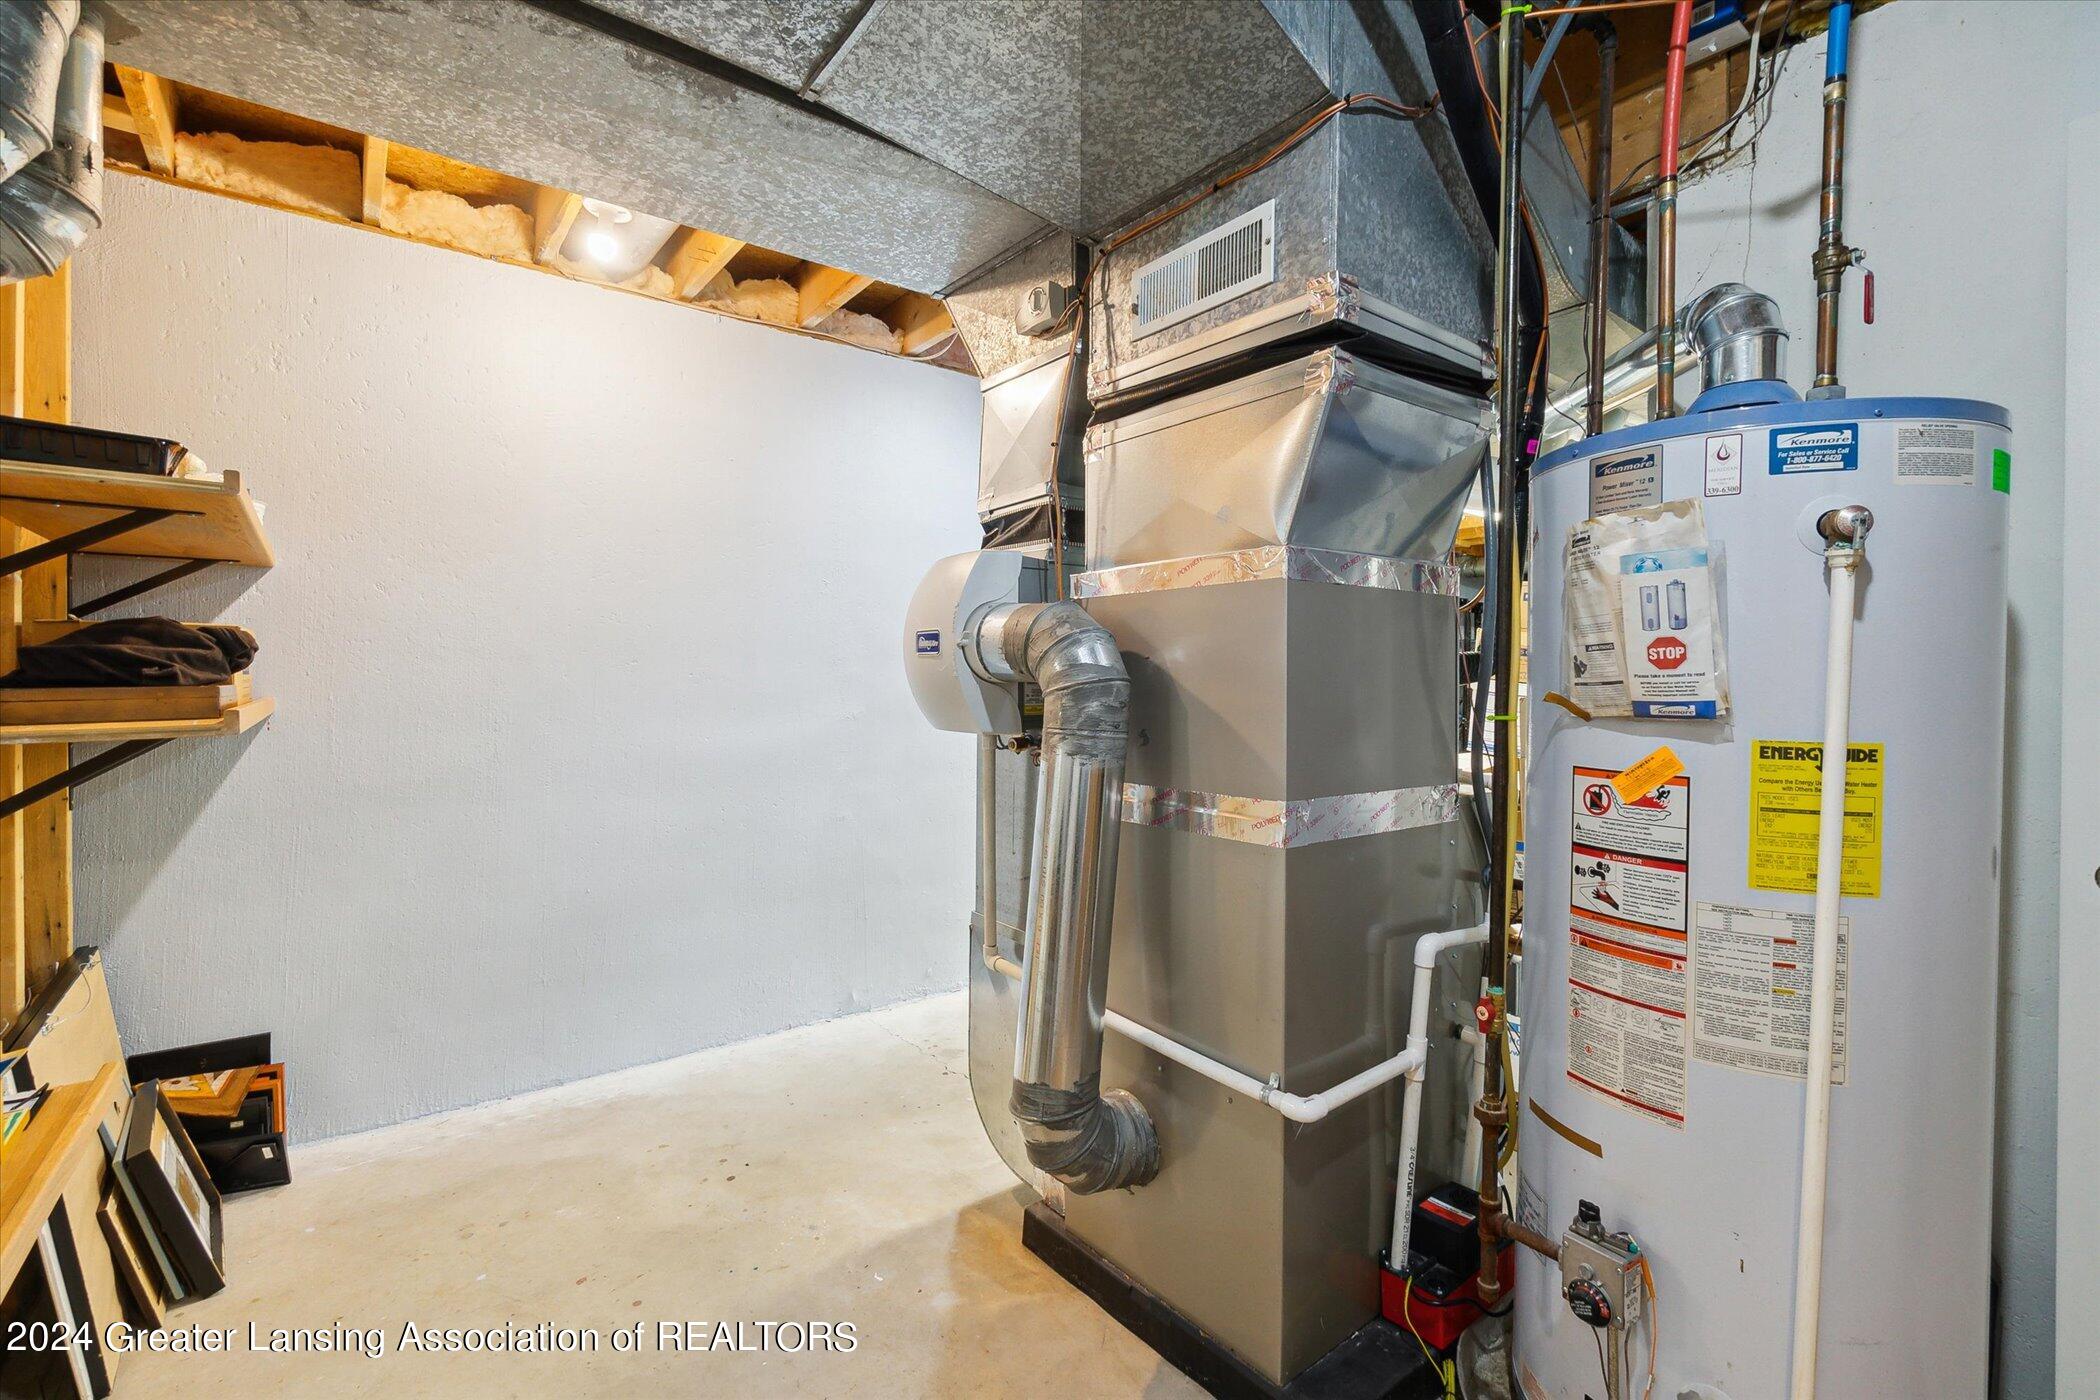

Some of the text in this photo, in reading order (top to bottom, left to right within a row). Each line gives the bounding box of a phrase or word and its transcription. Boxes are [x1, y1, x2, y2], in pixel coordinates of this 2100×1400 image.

[1790, 435, 1850, 446] Kenmore
[1603, 460, 1654, 475] Kenmore
[1649, 646, 1685, 660] STOP
[1613, 854, 1642, 864] DANGER
